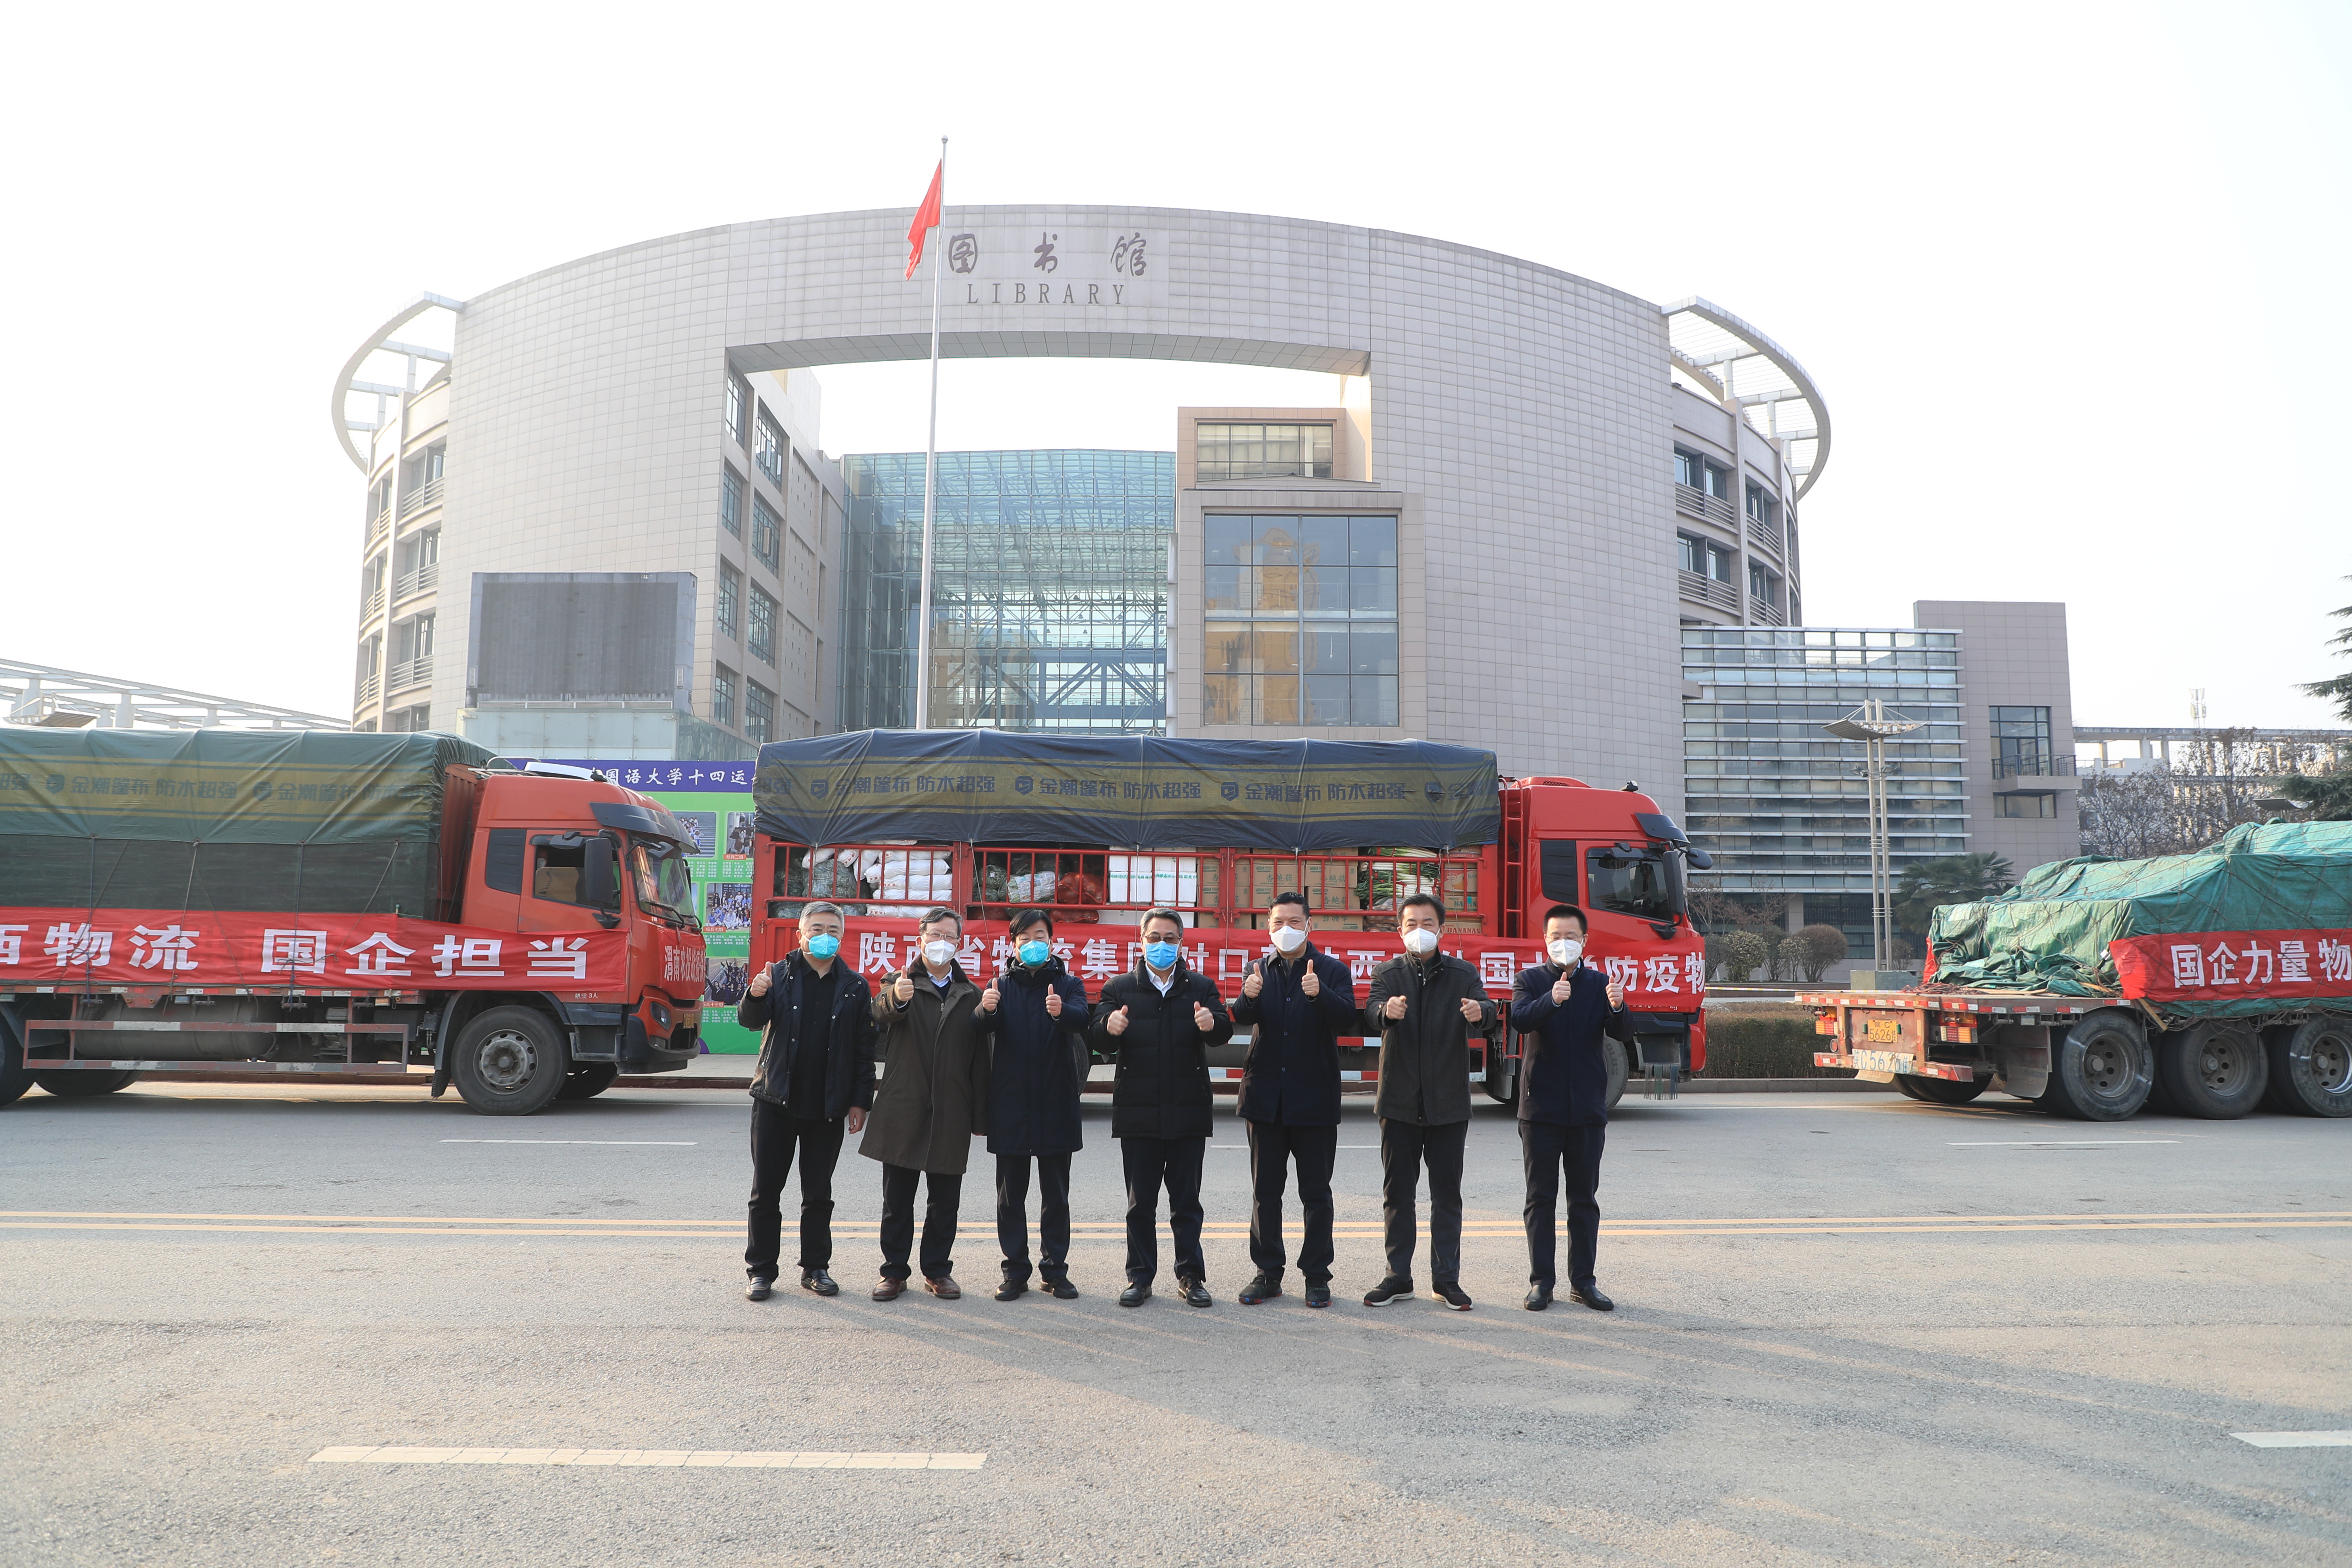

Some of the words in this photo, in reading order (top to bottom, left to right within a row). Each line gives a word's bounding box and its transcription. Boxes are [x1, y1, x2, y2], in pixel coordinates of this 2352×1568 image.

[948, 231, 1147, 277] 图书馆
[967, 283, 1125, 305] LIBRARY
[592, 767, 755, 786] 国语大学十四运
[916, 775, 995, 793] 防水超强
[155, 778, 237, 799] 防水超强
[1123, 781, 1201, 800] 防水超强
[1327, 782, 1406, 801] 防水超强
[1320, 875, 1345, 883] 鲍菇
[260, 928, 590, 979] 国企担当
